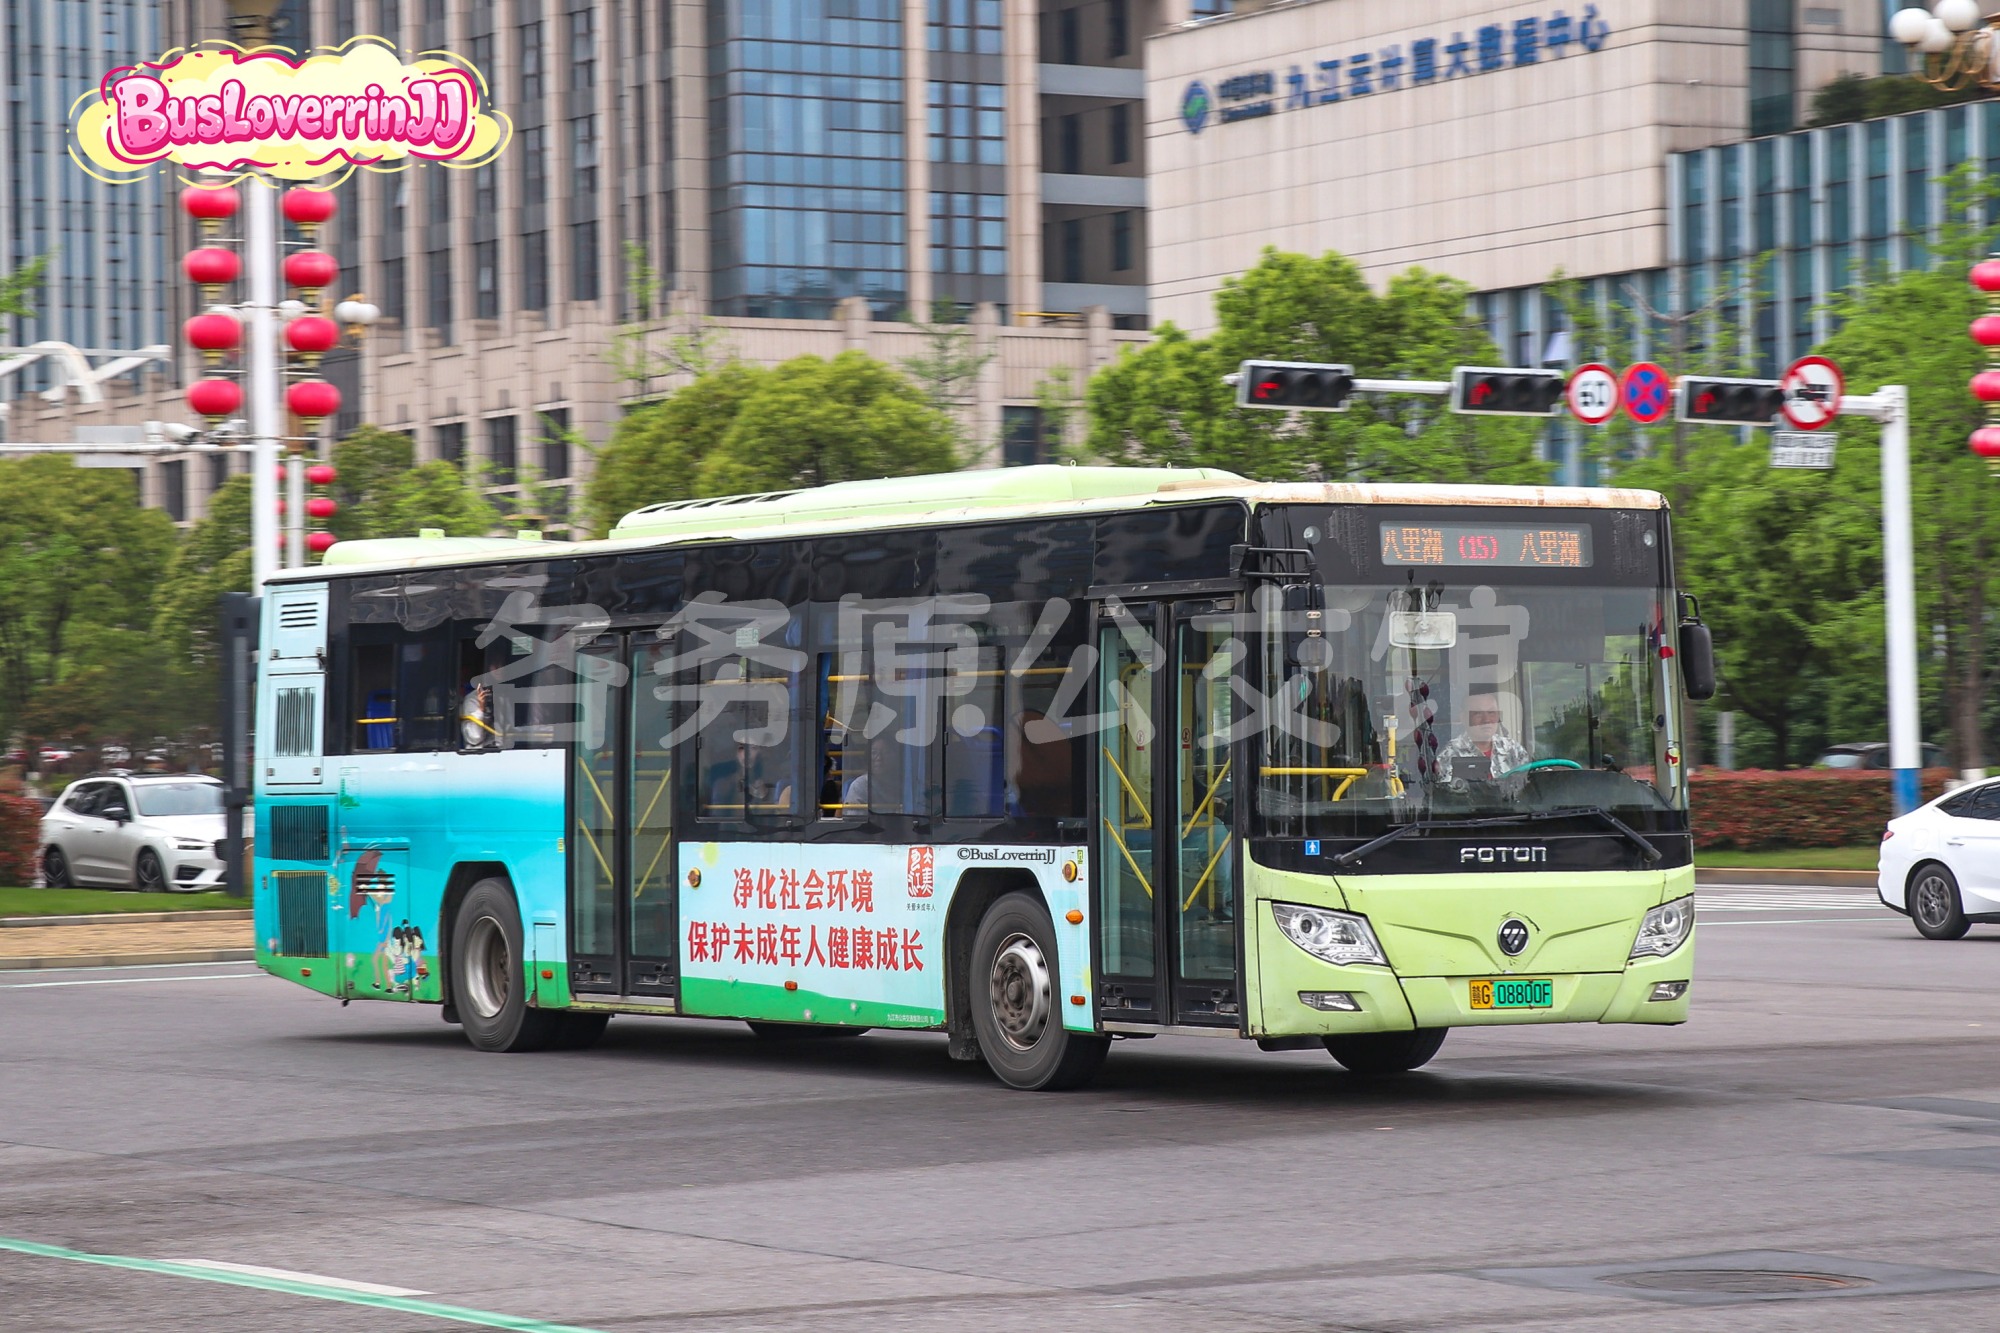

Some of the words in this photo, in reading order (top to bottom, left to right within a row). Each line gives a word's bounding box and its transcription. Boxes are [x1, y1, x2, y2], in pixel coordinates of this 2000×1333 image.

[1458, 535, 1500, 559] (15)
[1460, 847, 1547, 863] FOTON
[733, 867, 874, 913] 净化社会环境
[688, 921, 924, 972] 保护未成年人健康成长
